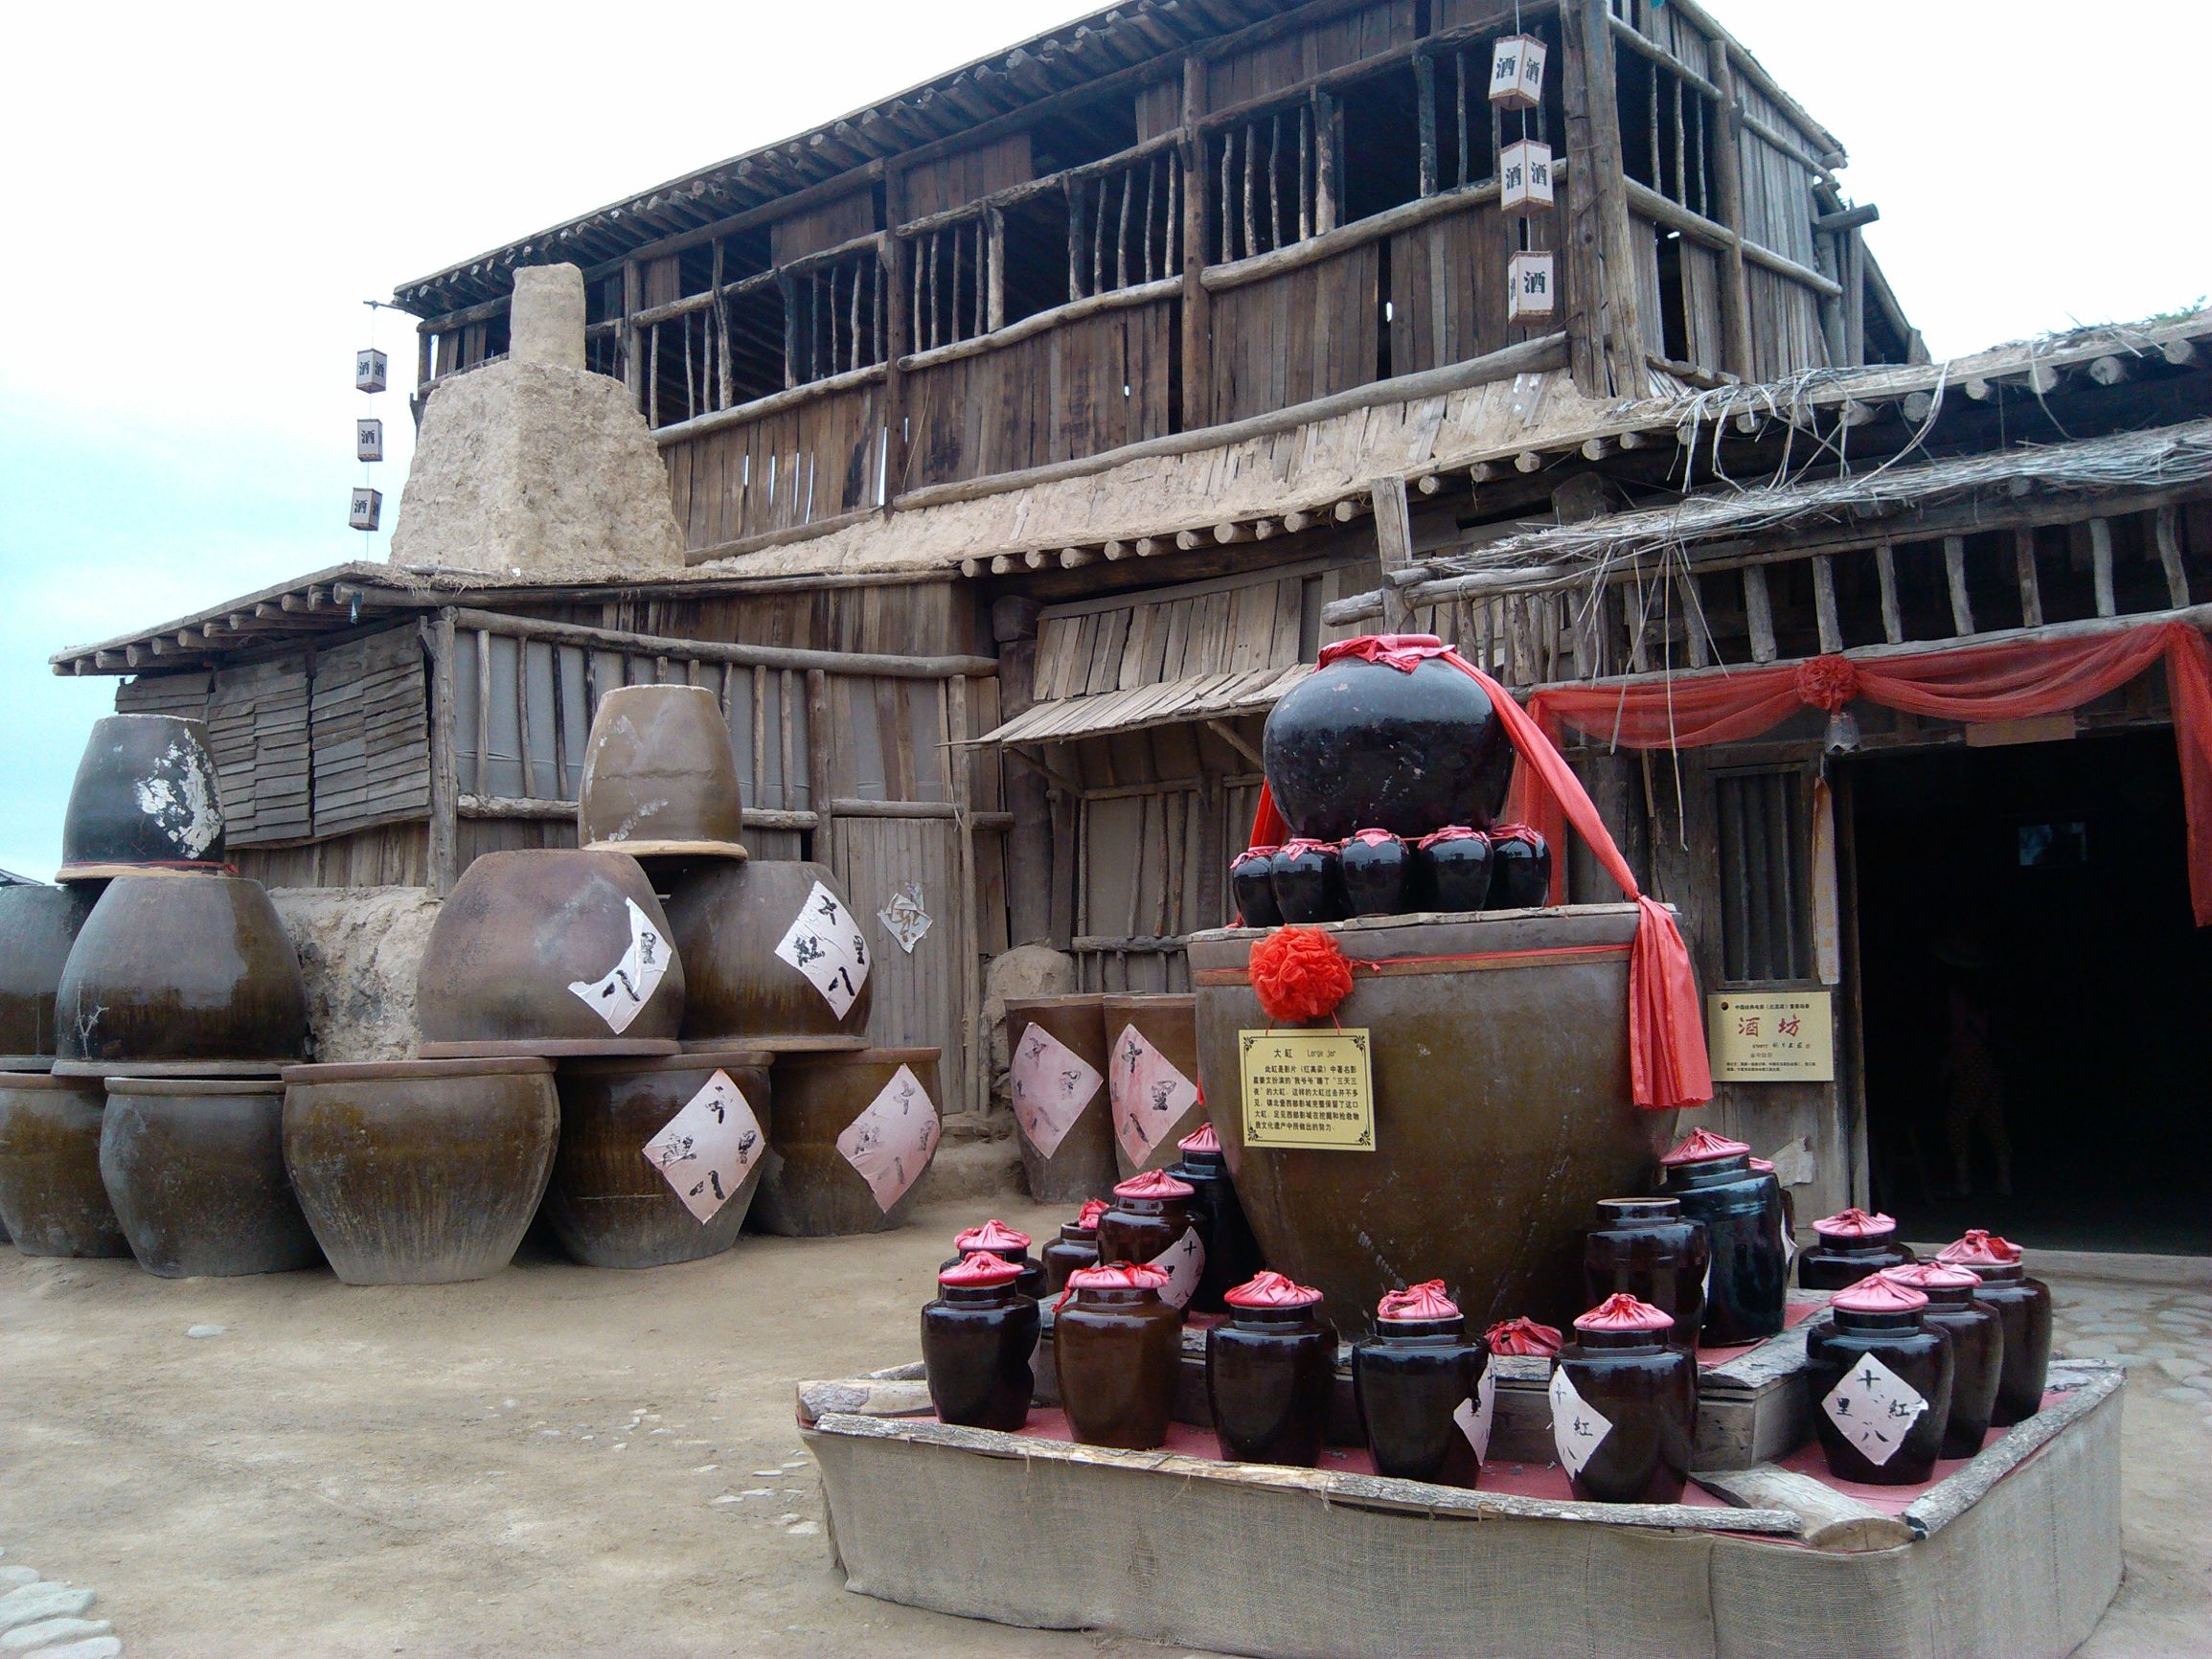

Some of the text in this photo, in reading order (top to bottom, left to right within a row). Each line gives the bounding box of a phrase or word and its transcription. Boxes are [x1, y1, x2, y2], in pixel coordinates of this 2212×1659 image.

[1495, 56, 1516, 80] 酒
[1525, 57, 1539, 85] 酒
[1505, 163, 1522, 190] 酒
[1530, 161, 1548, 187] 酒
[1523, 270, 1546, 294] 酒
[358, 360, 370, 376] 酒
[375, 361, 385, 377] 酒
[361, 429, 376, 444] 酒
[353, 499, 368, 514] 酒
[1738, 1013, 1801, 1037] 酒坊
[1273, 1048, 1293, 1058] 大缸
[1307, 1049, 1324, 1058] Large
[1183, 1240, 1197, 1257] 十
[1856, 1369, 1881, 1392] 十
[1555, 1382, 1567, 1406] 十
[1836, 1397, 1854, 1418] 里
[1860, 1429, 1890, 1443] 八
